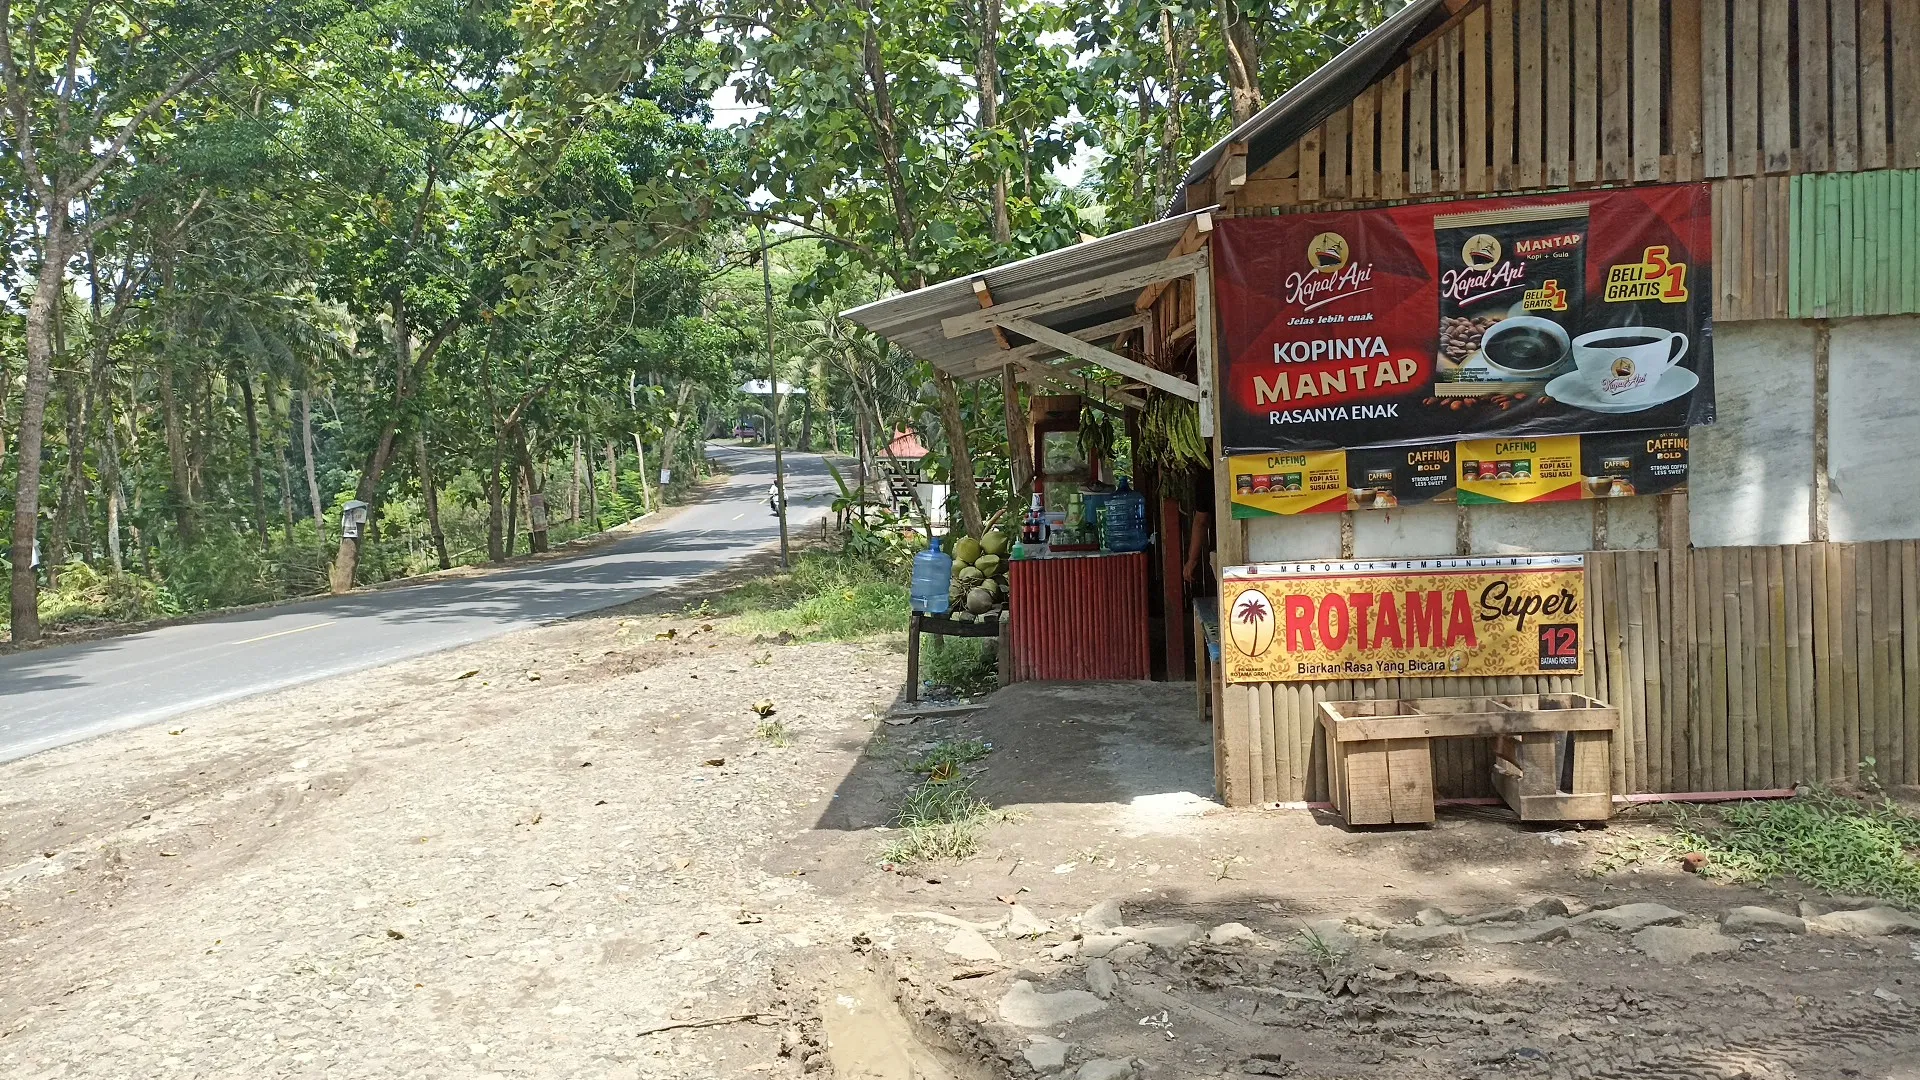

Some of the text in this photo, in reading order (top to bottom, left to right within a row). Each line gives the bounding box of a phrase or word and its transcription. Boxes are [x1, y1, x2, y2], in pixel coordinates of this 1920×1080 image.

[1515, 233, 1581, 254] MANTAP
[1611, 248, 1667, 283] BELI 5
[1285, 262, 1373, 306] Kapal Api
[1442, 261, 1525, 300] Kapal Api
[1526, 280, 1556, 300] BELI 5
[1607, 266, 1685, 300] GRATIS 1
[1523, 291, 1567, 310] GRATIS 1
[1287, 313, 1374, 326] Jelas lebih enak
[1273, 336, 1390, 364] KOPINYA
[1252, 358, 1418, 406] MANTAP
[1269, 403, 1399, 425] RASANYA ENAK
[1407, 450, 1450, 465] CAFFINO
[1495, 441, 1537, 455] CAFFINO
[1657, 452, 1682, 460] BOLD
[1267, 455, 1307, 469] CAFFINO
[1417, 463, 1441, 471] BOLD
[1604, 460, 1630, 469] CAFFINO
[1368, 472, 1393, 481] CAFFINO
[1280, 558, 1532, 573] MEROKOK MEMBUNUHMU
[1284, 580, 1578, 653] ROTAMA Super
[1541, 627, 1576, 656] 12
[1297, 659, 1446, 675] Biarkan Rasa Yang Bicara
[1540, 656, 1577, 665] BATANG KRETEK
